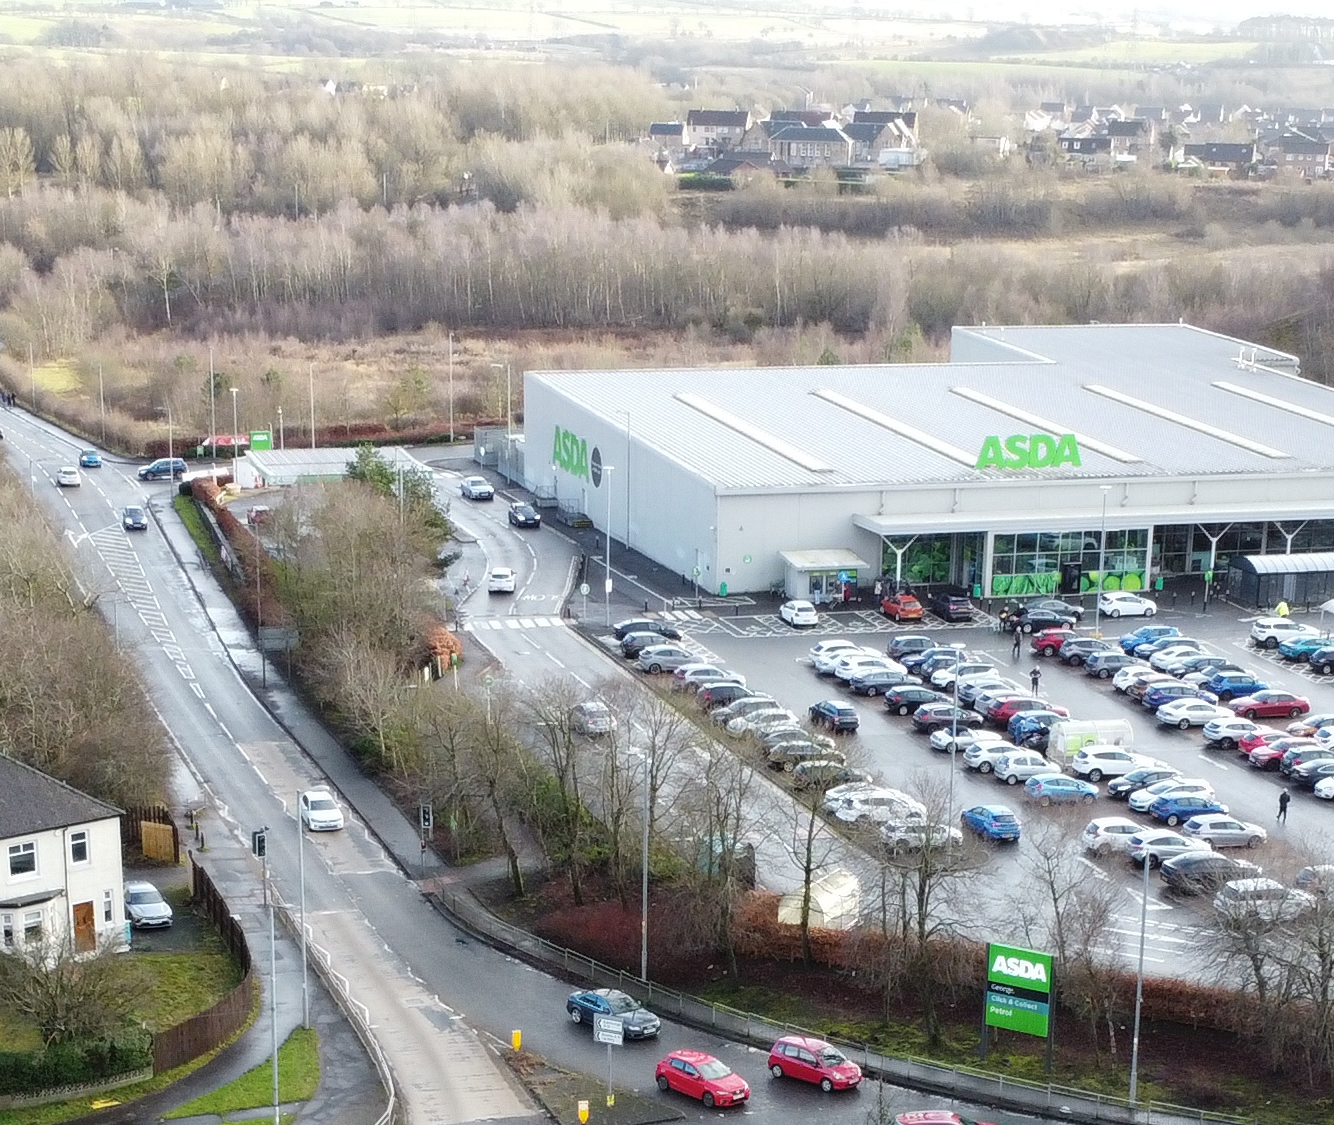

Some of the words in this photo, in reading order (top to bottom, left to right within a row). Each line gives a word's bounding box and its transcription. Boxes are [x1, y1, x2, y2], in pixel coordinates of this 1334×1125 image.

[553, 425, 590, 484] ASDA
[975, 433, 1082, 470] ASDA
[992, 955, 1047, 982] ASDA
[989, 1005, 1013, 1017] Petrol
[991, 995, 1008, 1004] Click
[1014, 1000, 1037, 1010] Collect
